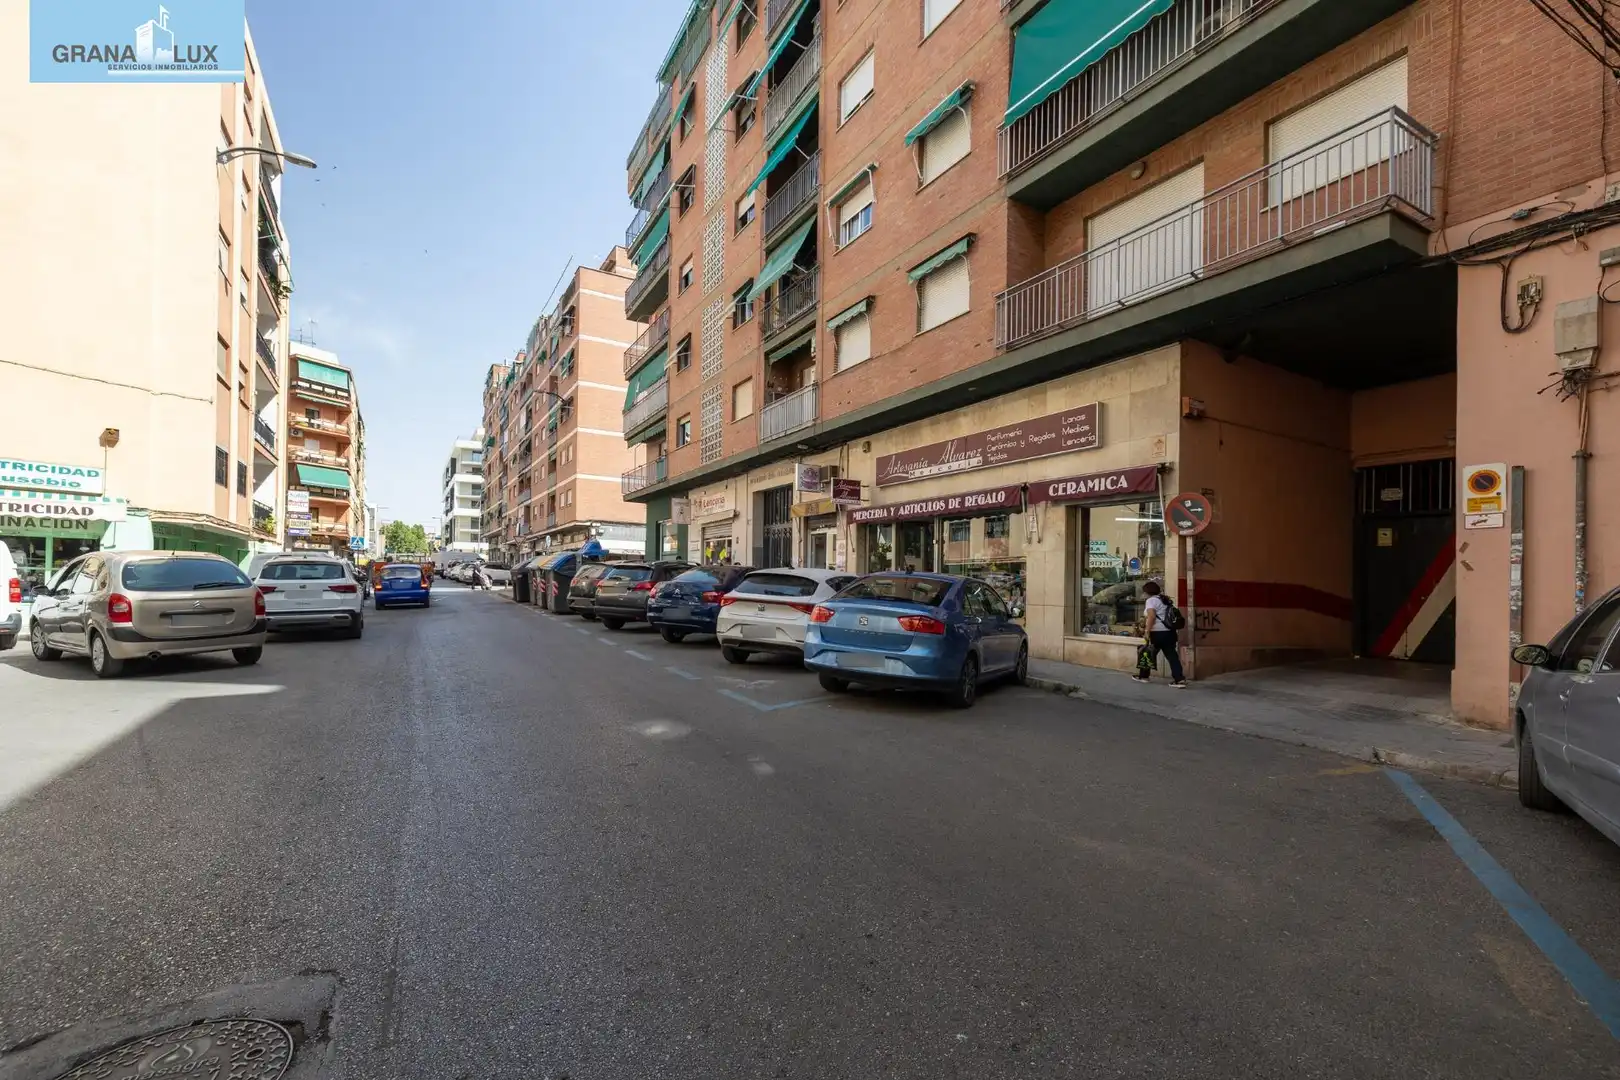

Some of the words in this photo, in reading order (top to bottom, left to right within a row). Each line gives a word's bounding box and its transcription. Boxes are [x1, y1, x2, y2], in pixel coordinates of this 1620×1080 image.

[1062, 414, 1086, 425] Lanas
[986, 427, 1023, 441] Perfumería
[1061, 424, 1090, 435] Medias
[1020, 439, 1026, 448] y
[1028, 431, 1056, 444] Regalos
[1061, 432, 1096, 447] Lencería
[936, 440, 983, 465] Alvarez
[987, 451, 1008, 463] Tejidos
[1, 475, 82, 488] usebio
[1048, 474, 1128, 496] CERAMICA
[852, 508, 888, 521] MERCERIA
[890, 506, 896, 517] Y
[897, 499, 946, 516] ARTICULOS
[948, 497, 961, 509] DE
[964, 490, 1006, 507] REGALO
